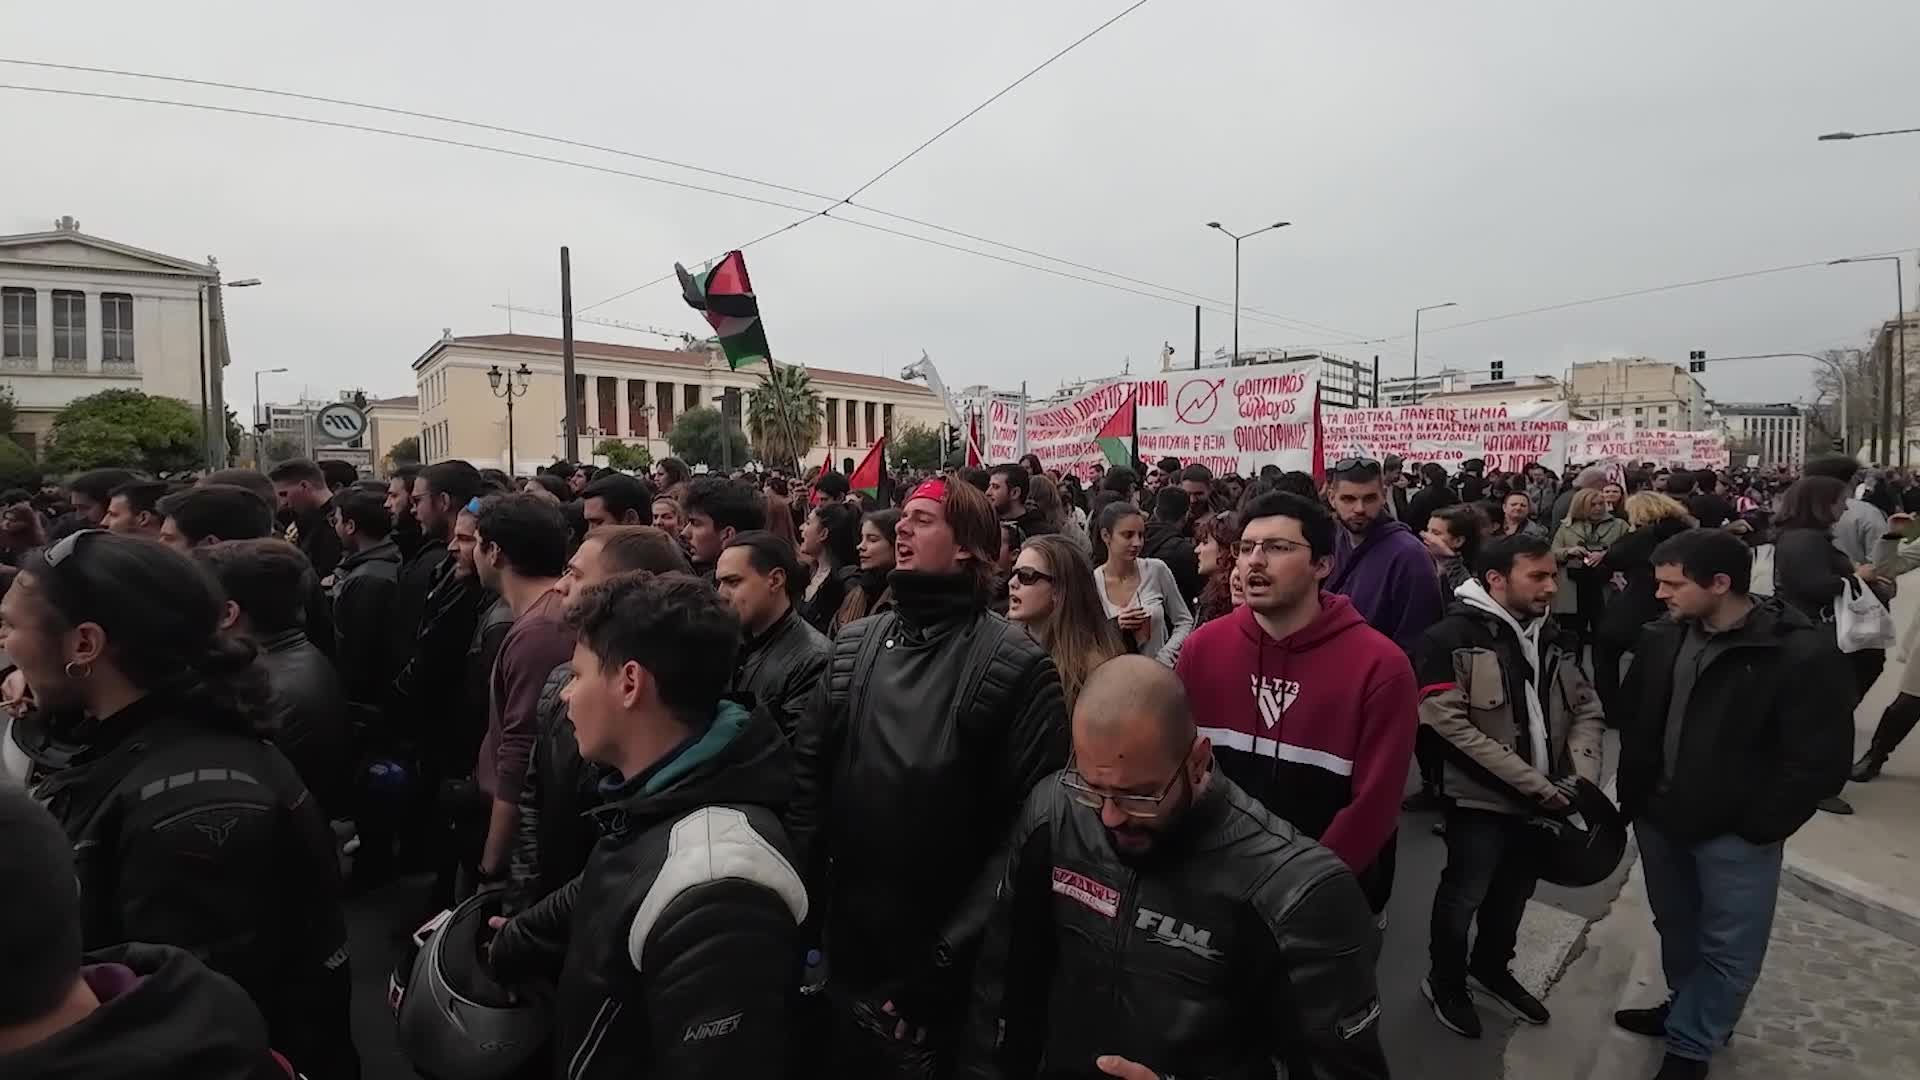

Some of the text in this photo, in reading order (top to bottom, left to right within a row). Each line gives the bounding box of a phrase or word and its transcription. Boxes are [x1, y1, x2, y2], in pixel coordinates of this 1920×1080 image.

[1327, 413, 1339, 425] ΤΑ
[1344, 410, 1393, 425] ΙΔΙΩΤΙΚΑ
[1136, 906, 1214, 949] FLM
[683, 1012, 744, 1042] WINTEX
